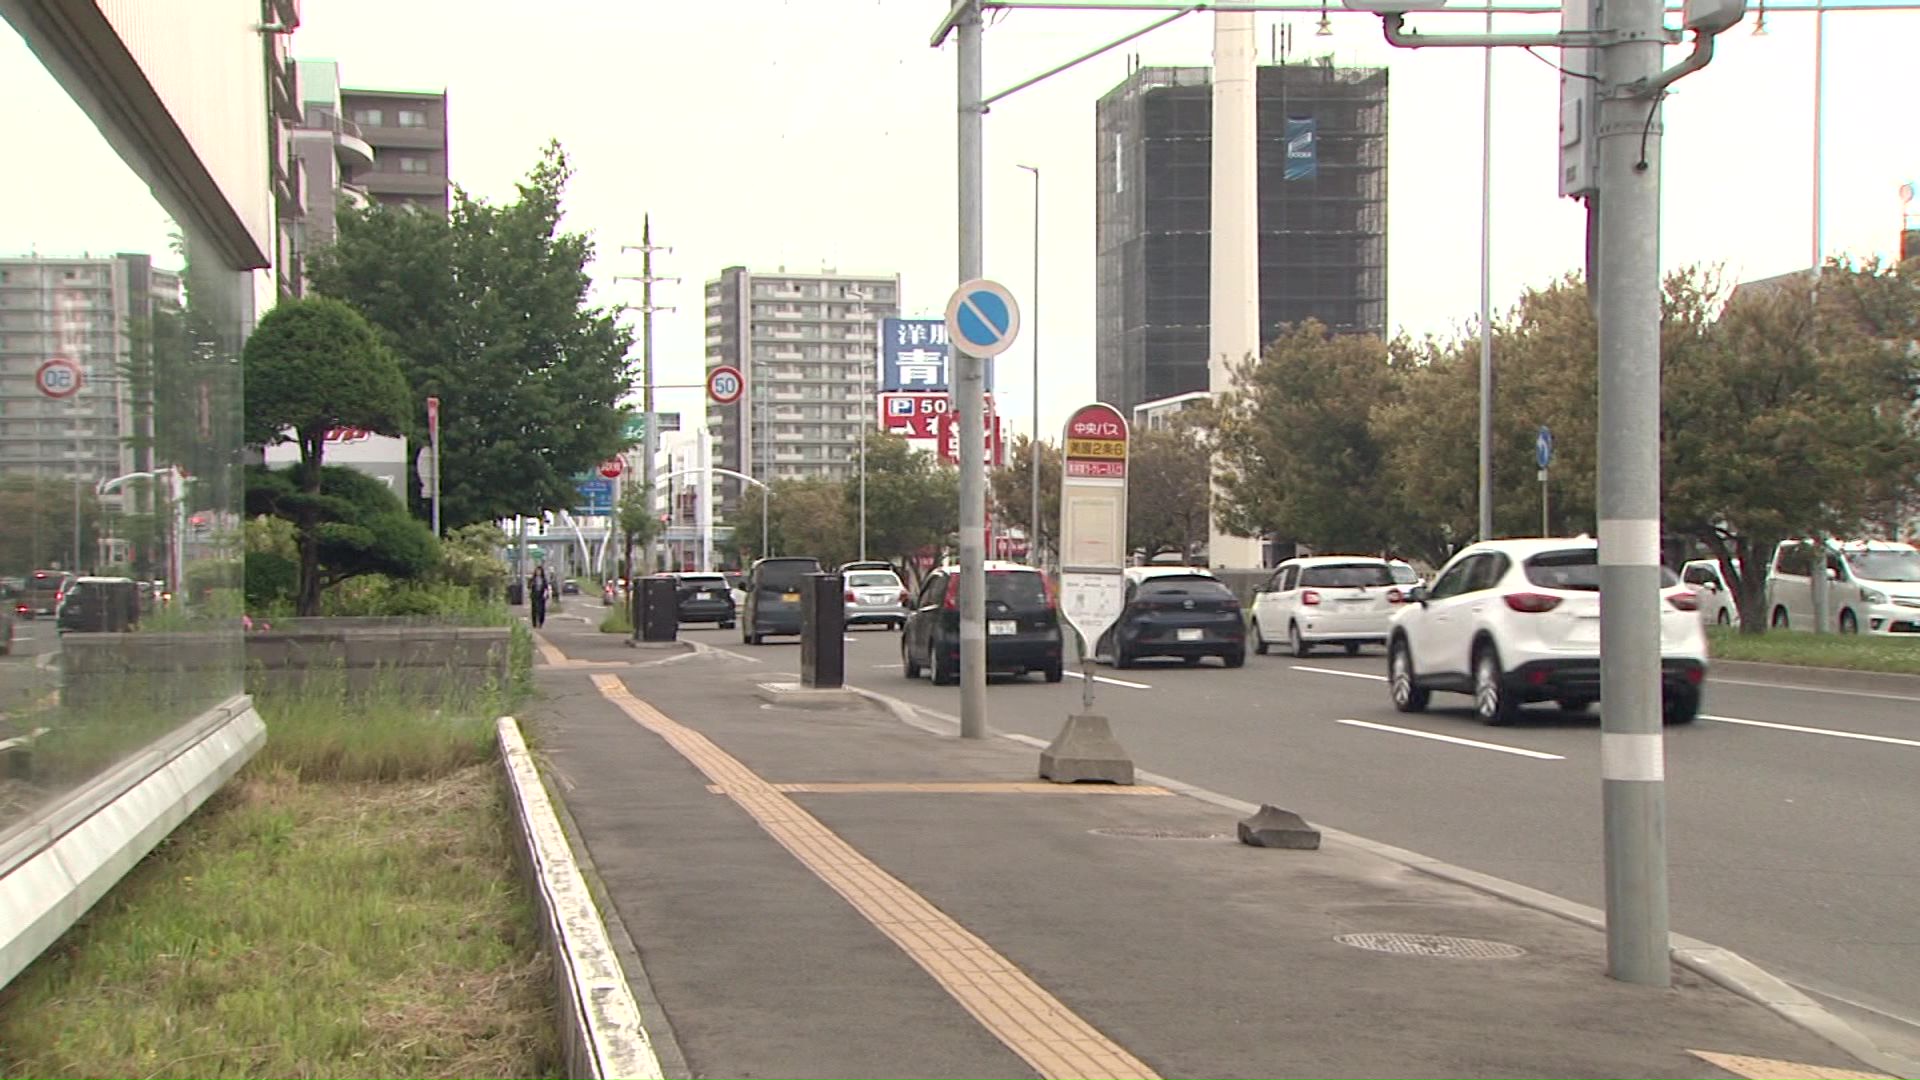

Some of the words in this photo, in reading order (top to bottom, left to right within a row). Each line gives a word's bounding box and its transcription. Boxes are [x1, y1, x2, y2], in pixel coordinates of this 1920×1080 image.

[715, 377, 736, 394] 50
[1074, 422, 1119, 435] 中央バス
